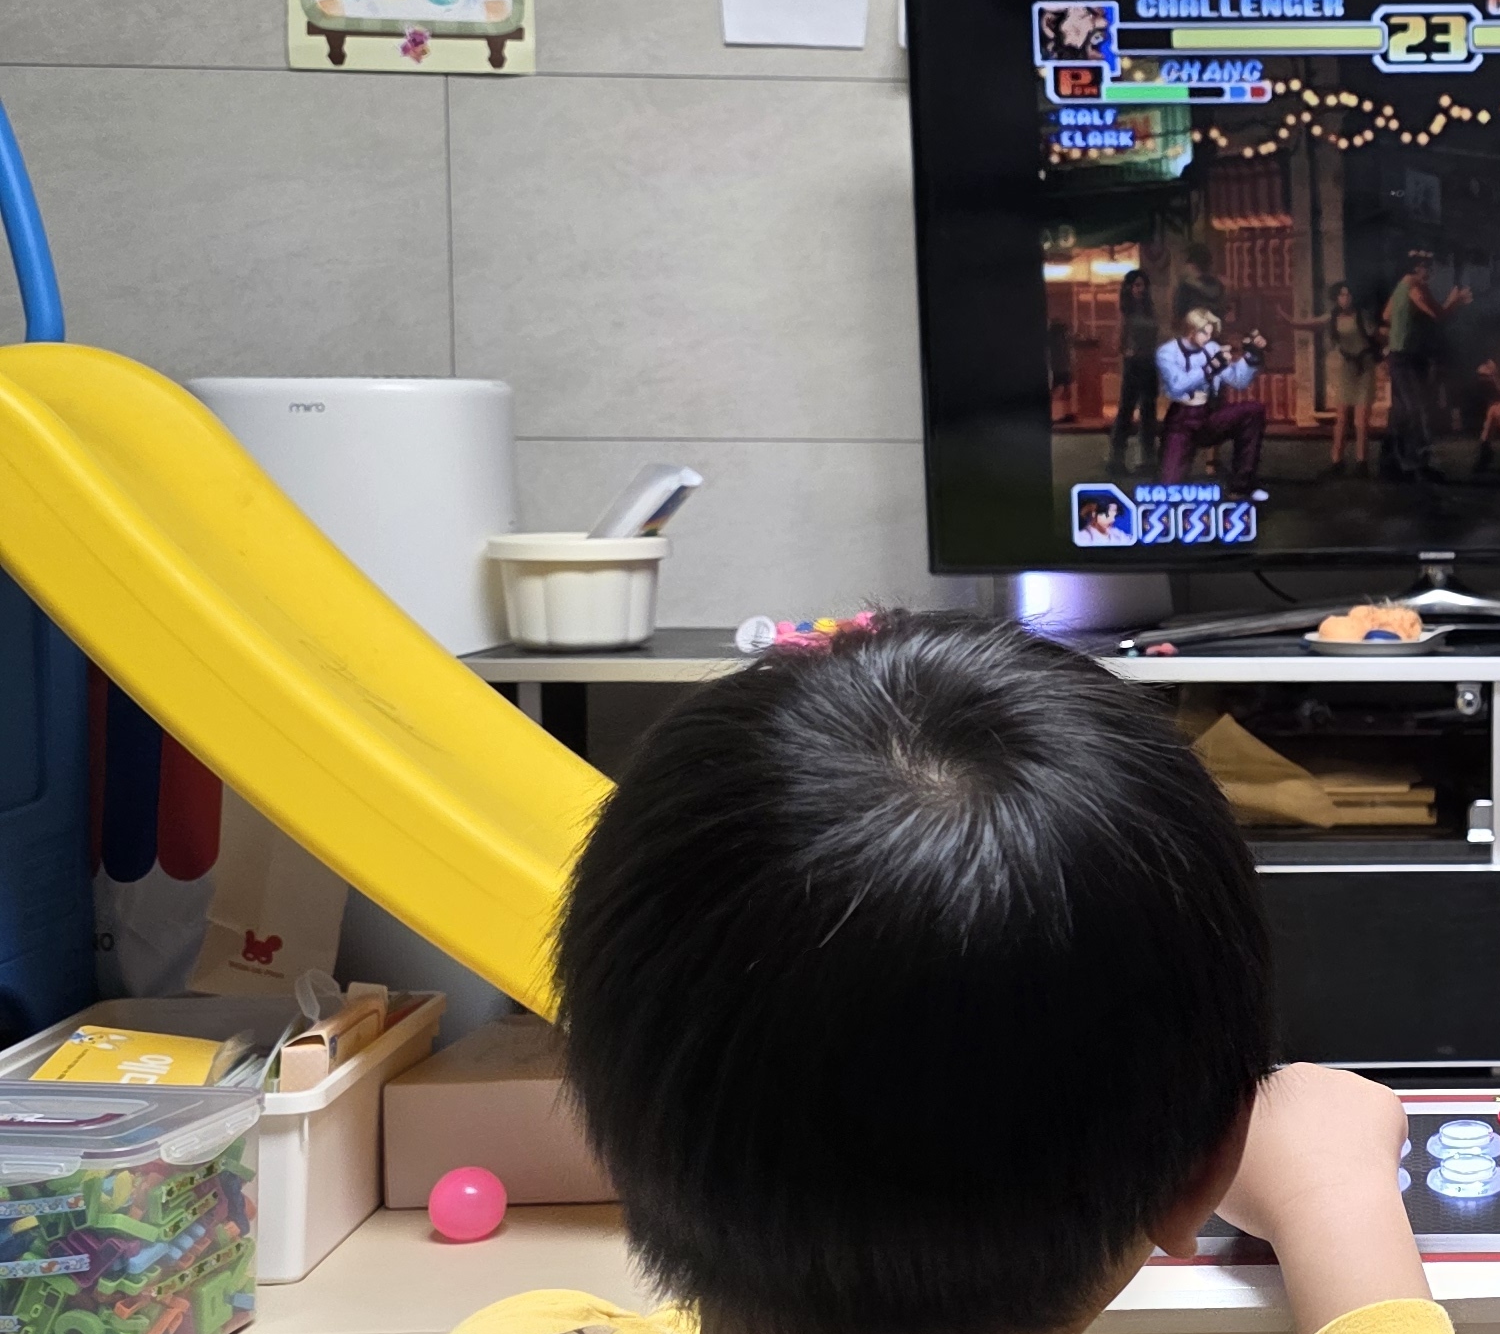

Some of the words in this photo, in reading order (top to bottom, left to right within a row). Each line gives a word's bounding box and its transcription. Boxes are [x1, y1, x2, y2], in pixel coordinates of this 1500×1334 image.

[1387, 14, 1468, 63] 23
[1160, 59, 1263, 82] CHANG
[1059, 107, 1117, 126] RALF
[1060, 129, 1134, 148] CLARK
[1134, 483, 1221, 504] KASUMI
